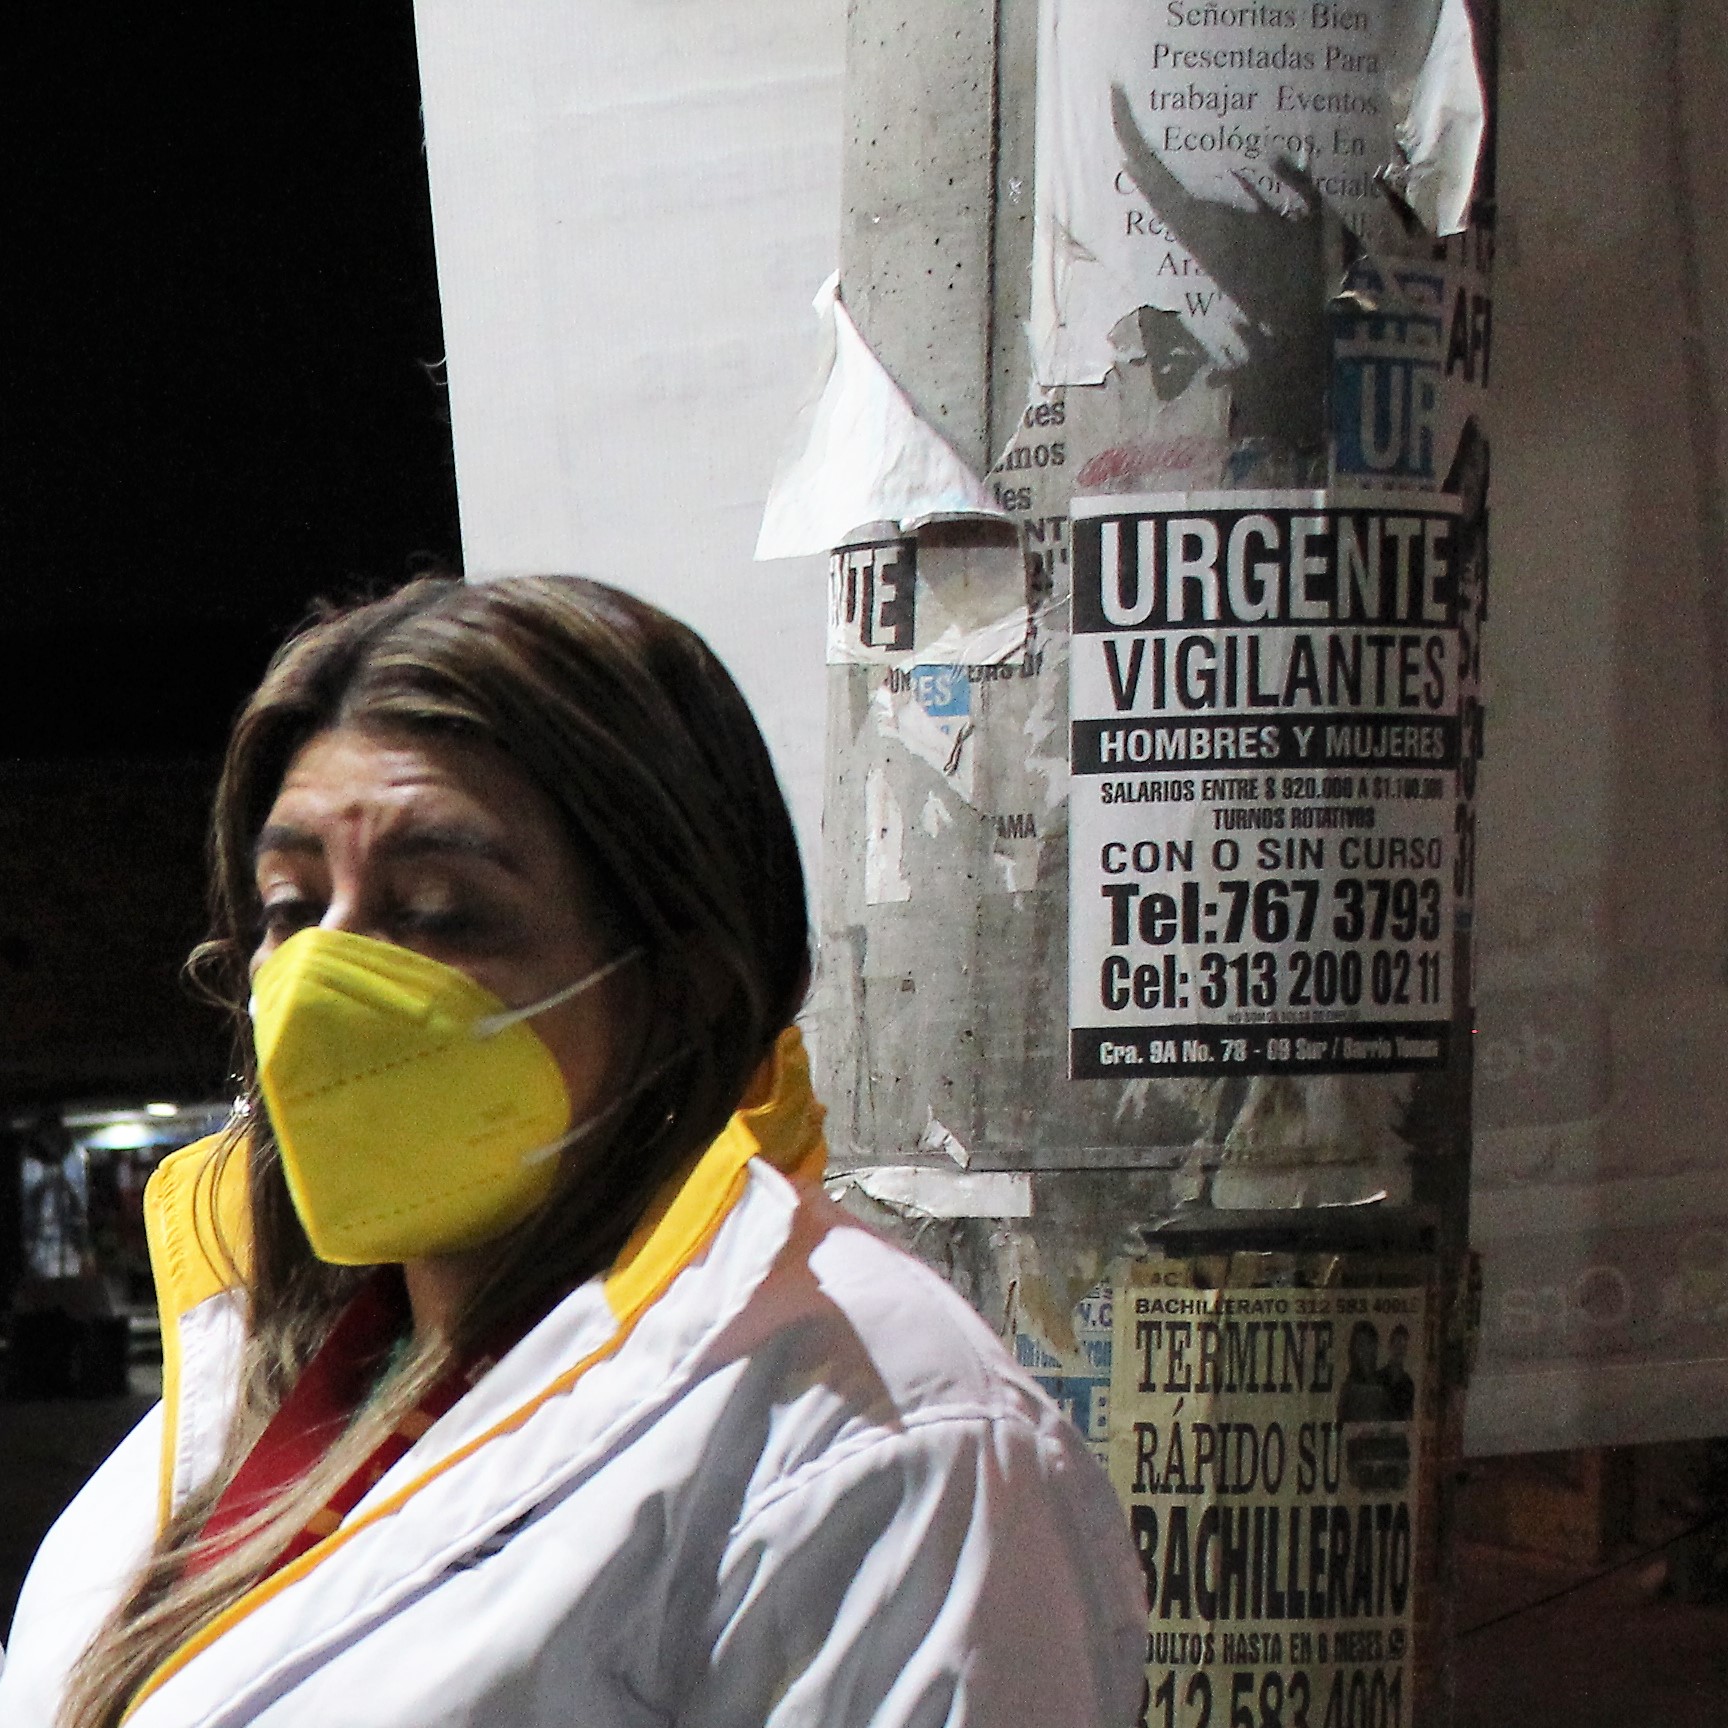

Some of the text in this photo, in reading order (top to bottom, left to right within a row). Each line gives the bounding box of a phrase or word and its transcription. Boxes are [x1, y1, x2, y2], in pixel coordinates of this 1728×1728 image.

[1167, 0, 1369, 32] Señoritas Bien
[1152, 44, 1379, 74] Presentadas Para
[1149, 84, 1379, 117] trabajar Eventos
[1099, 513, 1450, 627] URGENTE
[1102, 634, 1445, 712] VIGILANTES
[1100, 725, 1446, 764] HOMBRES Y MUJERES
[1101, 778, 1194, 804] SALARIOS
[1201, 778, 1259, 802] ENTRE
[1212, 807, 1286, 831] TURNOS
[1100, 837, 1442, 874] CON O SIN CURSO
[1332, 877, 1441, 944] 3793
[1100, 953, 1189, 1011] Cel:
[1198, 950, 1278, 1008] 313
[1287, 949, 1363, 1007] 200
[1099, 1040, 1143, 1065] Cra.
[1182, 1038, 1215, 1063] No.
[1135, 1298, 1288, 1315] BACHILLERATO
[1135, 1320, 1334, 1393] TERMINE
[1131, 1396, 1286, 1495] RÁPIDO
[1297, 1420, 1344, 1495] SU
[1130, 1502, 1411, 1621] BACHILLERATO
[1222, 1631, 1283, 1664] HASTA
[1290, 1631, 1313, 1664] EN
